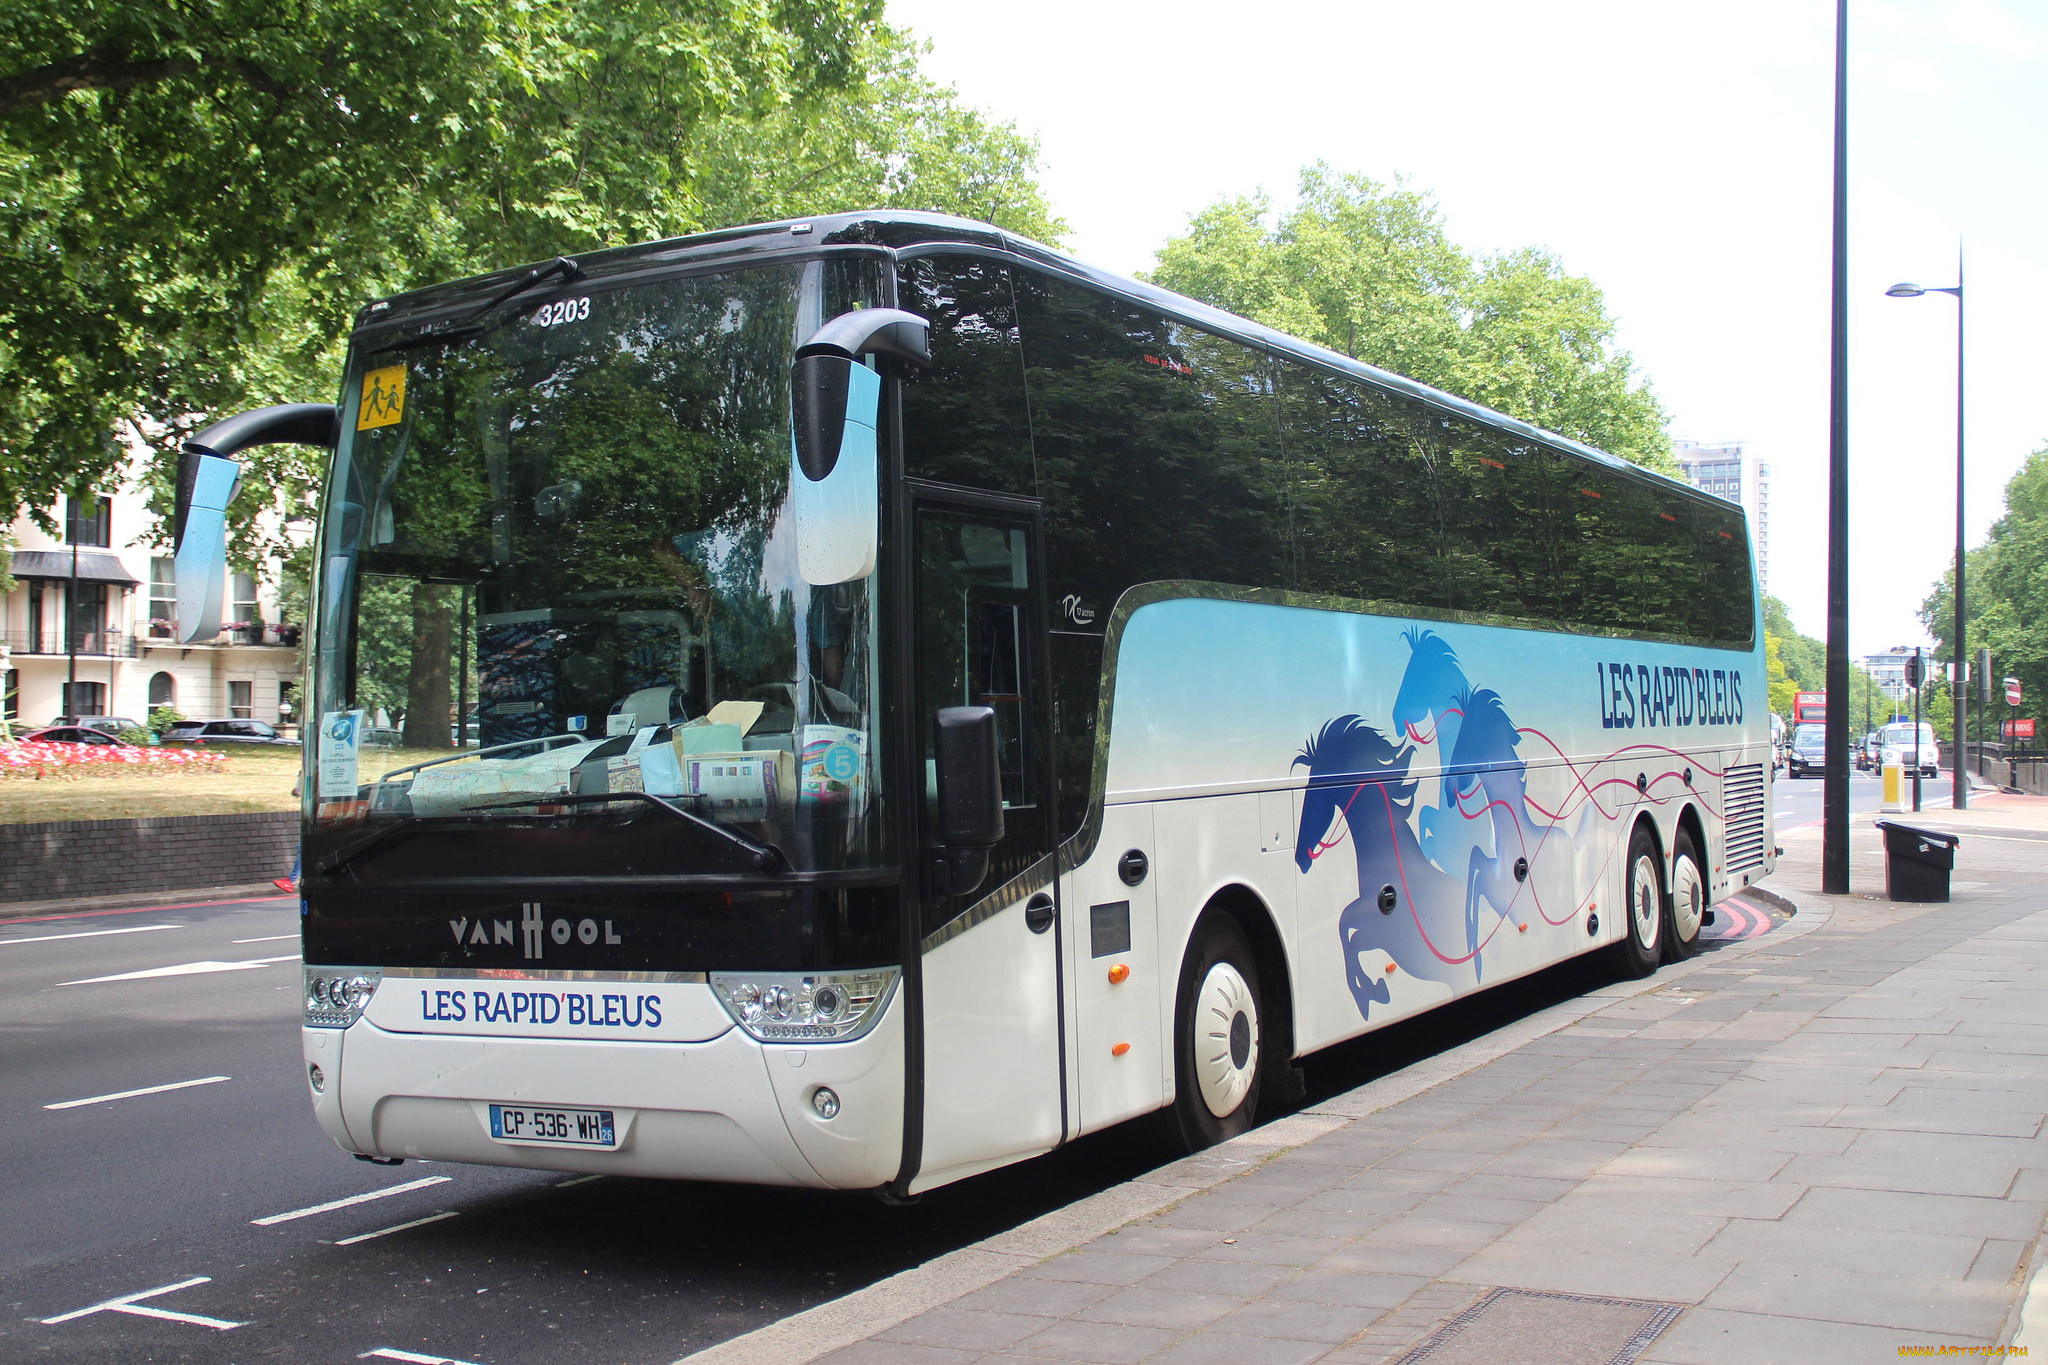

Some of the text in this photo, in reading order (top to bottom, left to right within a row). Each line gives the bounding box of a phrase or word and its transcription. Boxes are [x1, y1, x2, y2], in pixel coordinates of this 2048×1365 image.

[540, 296, 590, 328] 3203
[1598, 662, 1743, 729] LES RAPID'BLEUS
[834, 754, 851, 777] 5
[421, 990, 662, 1028] LES RAPID'BLEUS
[601, 1129, 613, 1141] 26
